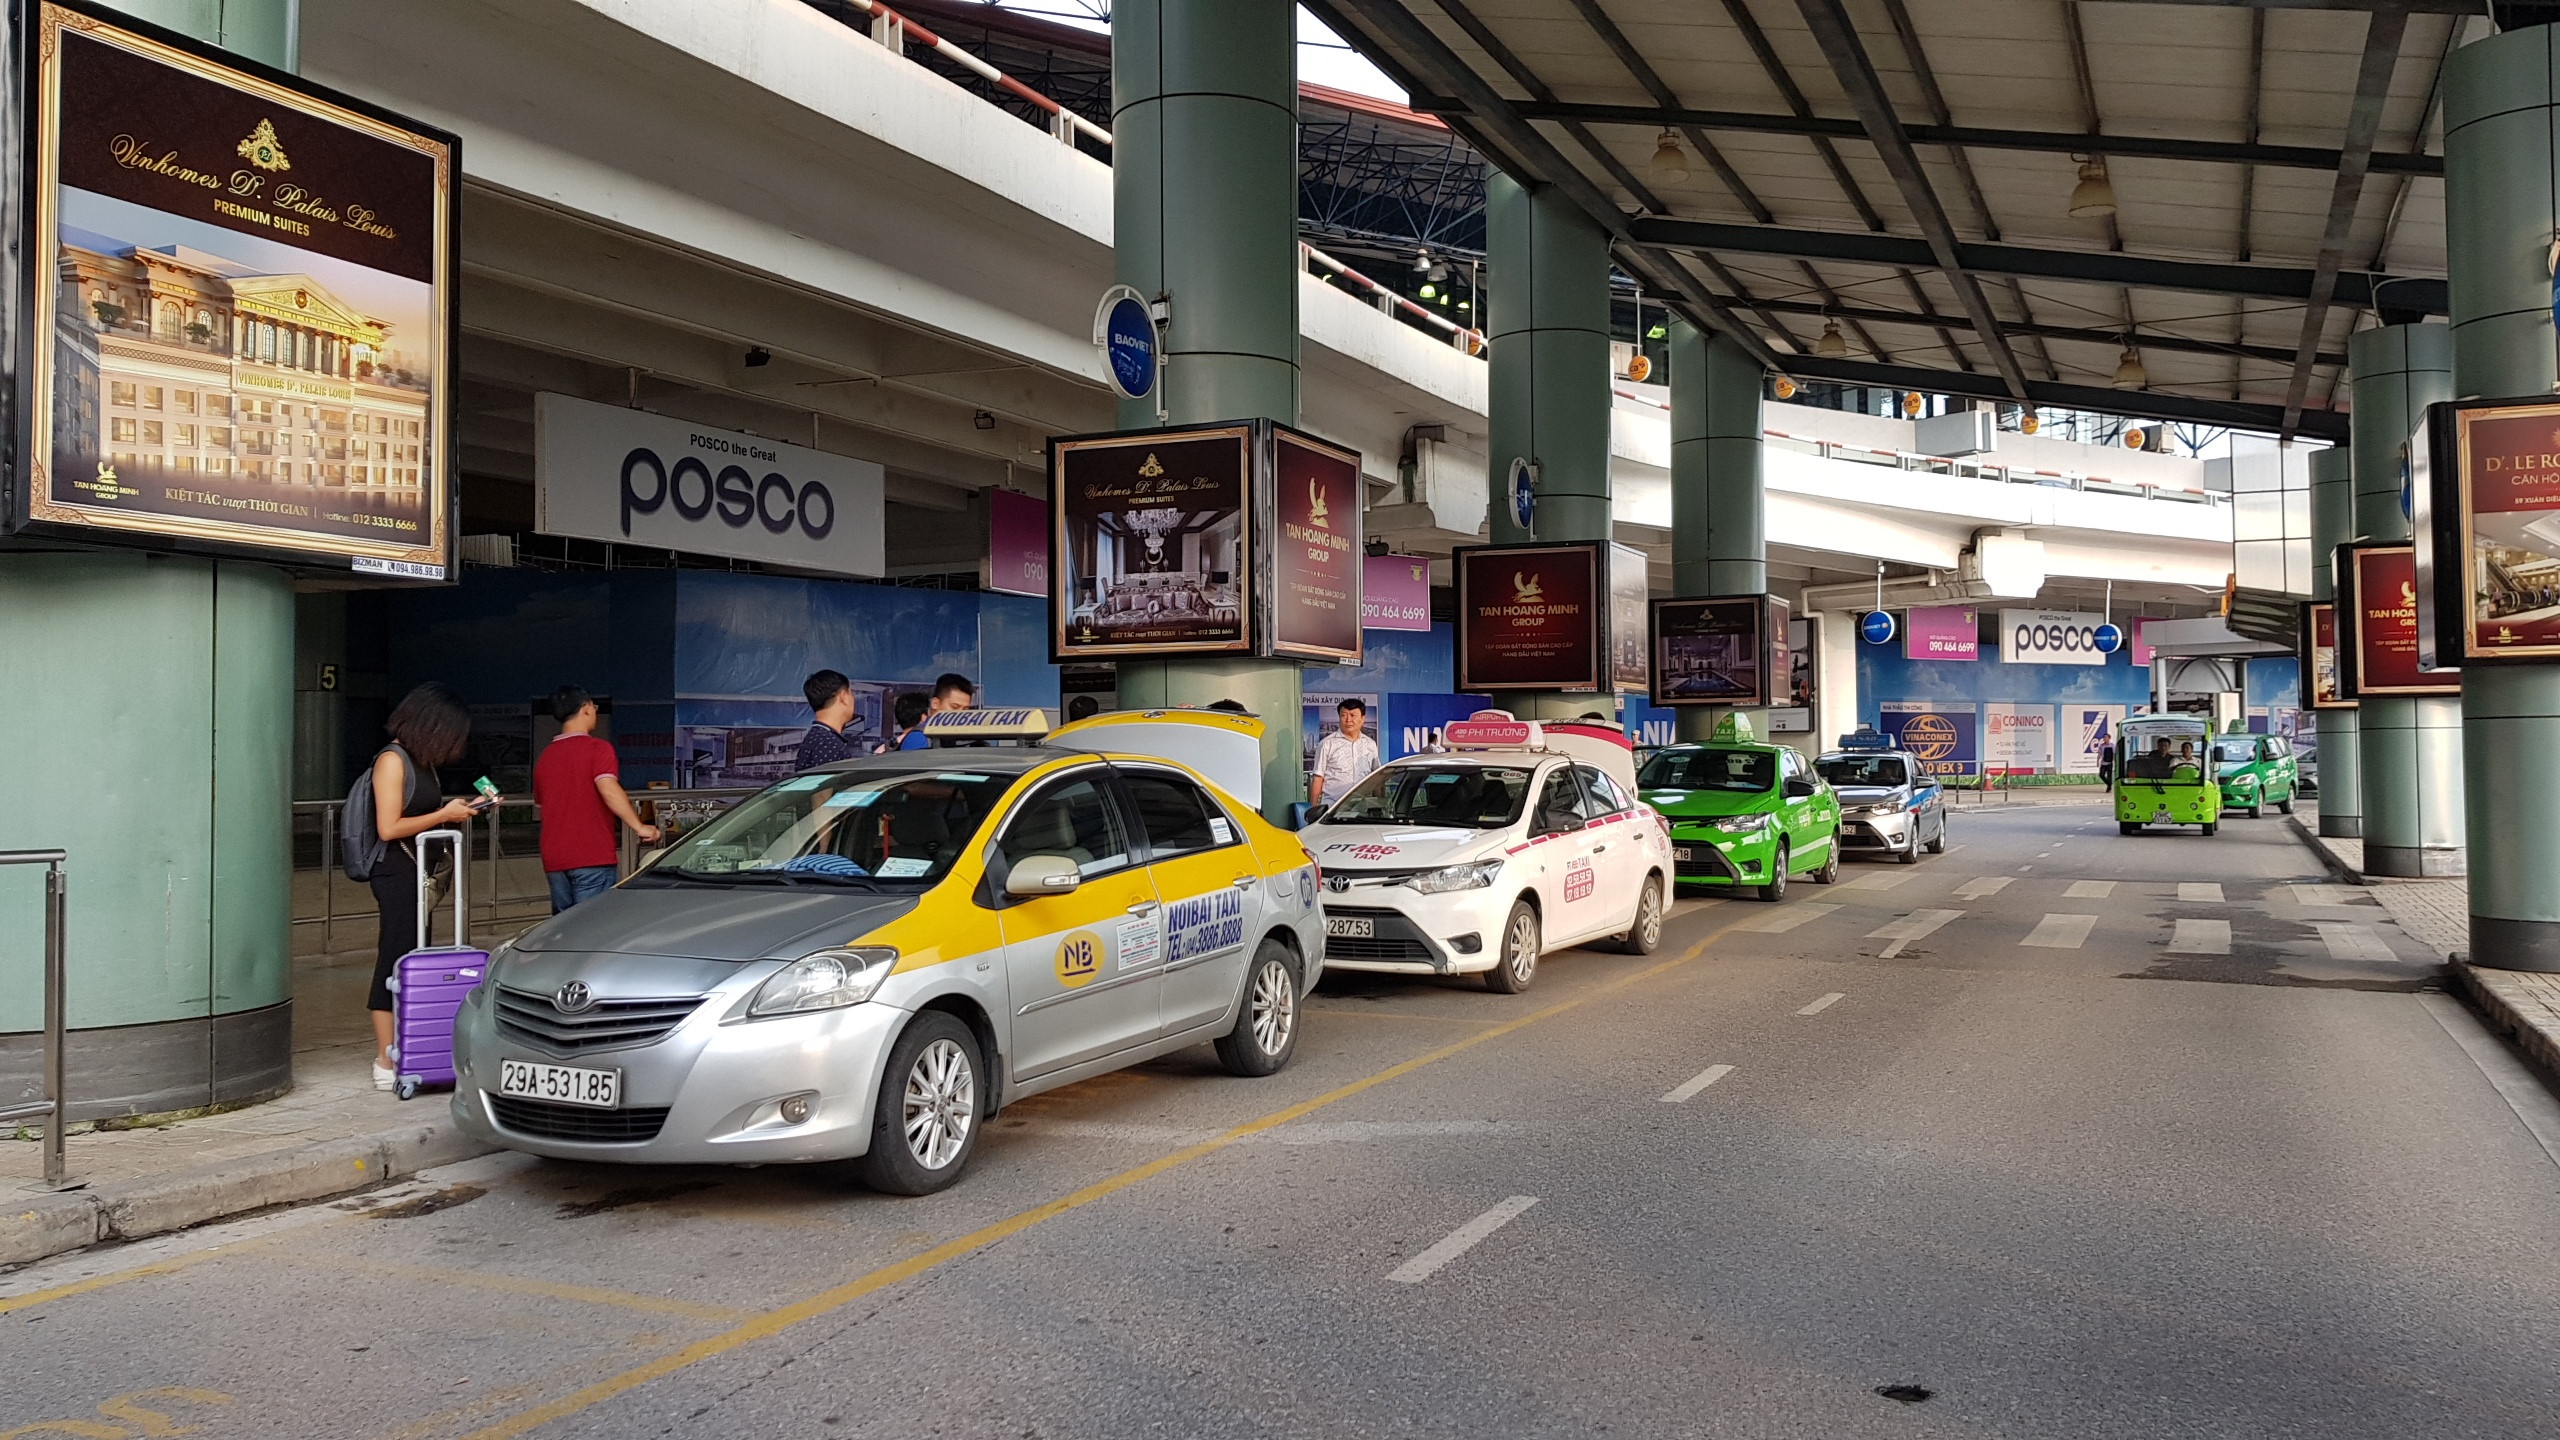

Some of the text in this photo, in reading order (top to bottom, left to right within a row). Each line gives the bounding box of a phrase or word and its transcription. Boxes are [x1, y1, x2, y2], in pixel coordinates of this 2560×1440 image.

[111, 134, 222, 189] Vinhomes
[273, 183, 340, 222] Palais
[343, 205, 397, 240] Louis
[214, 199, 310, 237] PREMIUM SUITES
[239, 372, 284, 390] VINHOMES
[690, 433, 777, 463] POSCO the Great
[2515, 454, 2535, 470] LE
[1084, 484, 1132, 499] Vinhomes
[1156, 479, 1190, 493] Palais
[1191, 476, 1219, 490] Louis
[2511, 474, 2539, 486] CĂN
[74, 481, 140, 496] TAN HOANG MINH
[95, 492, 118, 500] GROUP
[621, 447, 834, 541] posco
[1156, 495, 1175, 503] SUITES
[165, 487, 194, 503] KIỆT
[196, 491, 221, 506] TÁC
[223, 497, 247, 511] vượt
[248, 499, 278, 513] THỜI
[280, 504, 308, 517] GIAN
[352, 513, 370, 525] 012
[371, 516, 393, 528] 3333
[395, 519, 418, 531] 6666
[1286, 522, 1350, 552] TAN HOANG MINH
[353, 557, 383, 568] BIZMAN
[1308, 547, 1330, 563] GROUP
[1024, 562, 1043, 580] 090
[1362, 604, 1425, 620] 090 464 6699
[1479, 604, 1579, 617] TAN HOANG MINH
[2368, 609, 2390, 619] TAN
[1512, 617, 1545, 626] GROUP
[1929, 641, 1975, 653] 090 464 6699
[2016, 624, 2094, 660] posco
[321, 664, 335, 689] 5
[1321, 695, 1333, 703] XÂY
[929, 711, 1031, 726] NOIBAI TAXI
[2003, 715, 2044, 727] CONINCO
[1468, 727, 1527, 736] PHI TRƯỜNG
[1905, 733, 1953, 741] VINACONEX
[1578, 856, 1590, 868] TAXI
[1168, 889, 1241, 933] NOIBAI TAXI
[1064, 940, 1094, 969] NB
[504, 1063, 613, 1102] 29A-531.85
